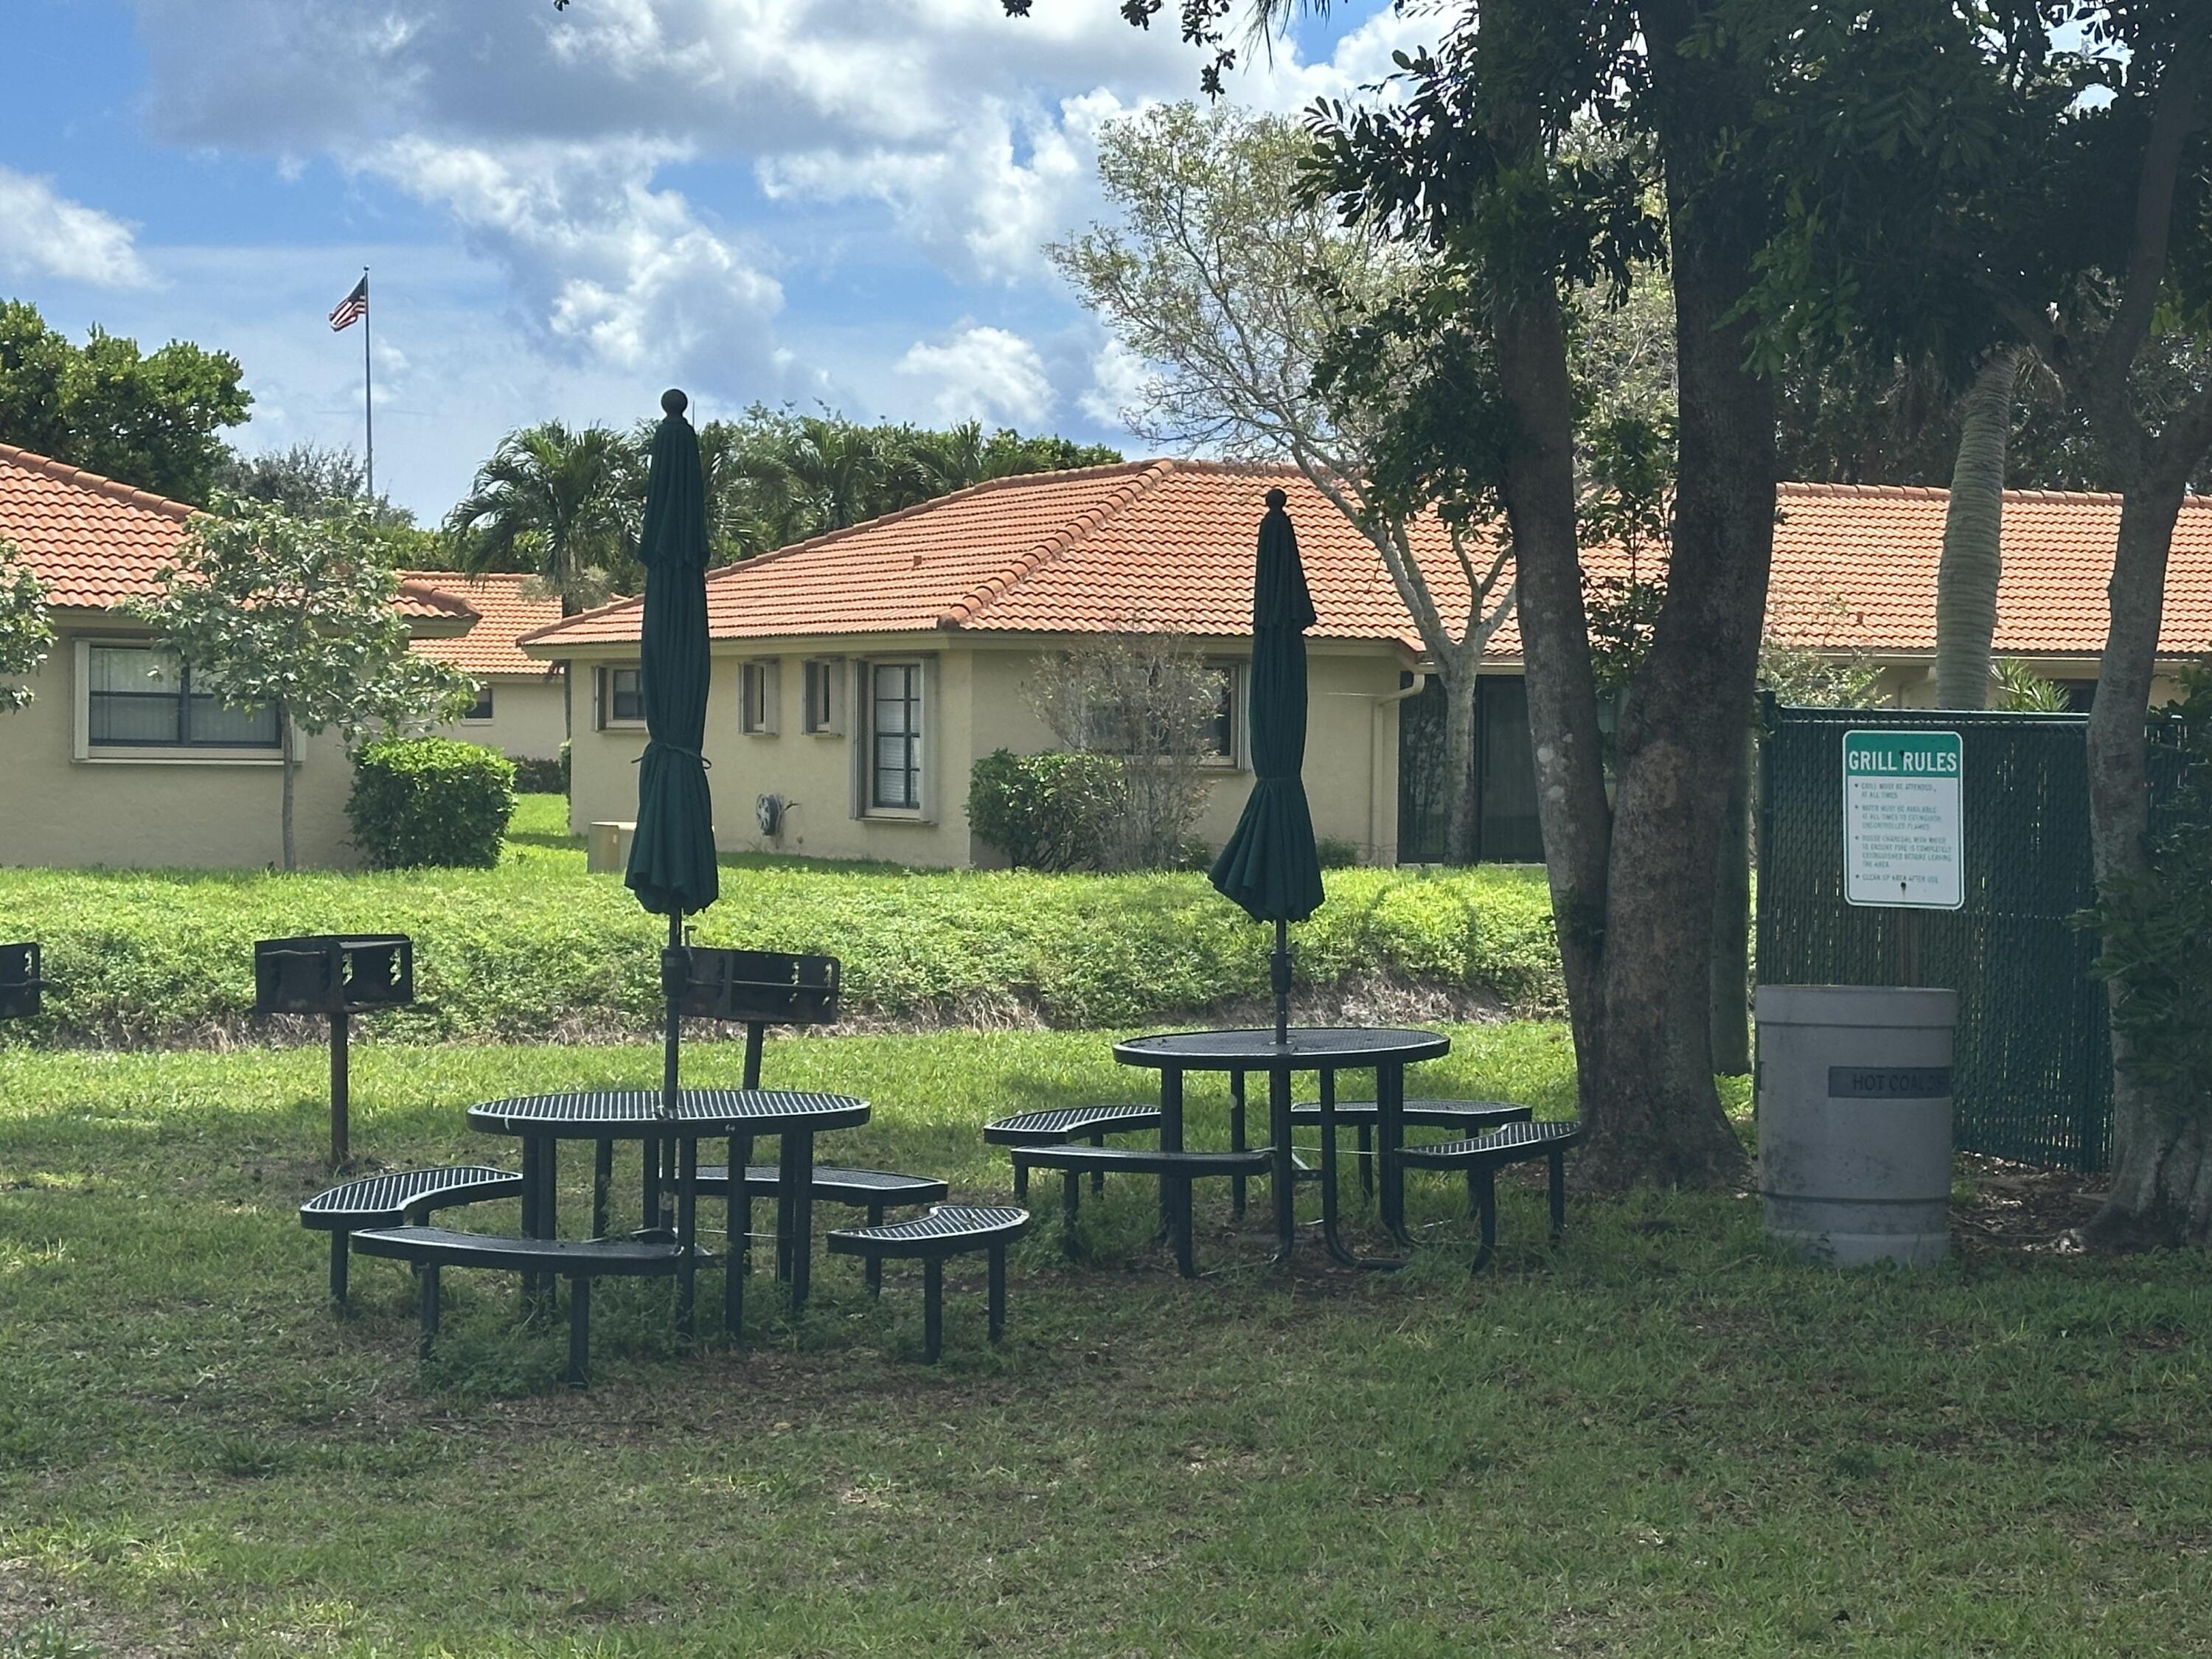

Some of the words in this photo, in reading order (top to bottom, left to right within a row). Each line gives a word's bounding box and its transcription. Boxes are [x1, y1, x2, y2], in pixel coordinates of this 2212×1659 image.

[1848, 751, 1897, 771] GRILL
[1903, 751, 1957, 771] RULES
[1853, 1074, 1885, 1091] HOT
